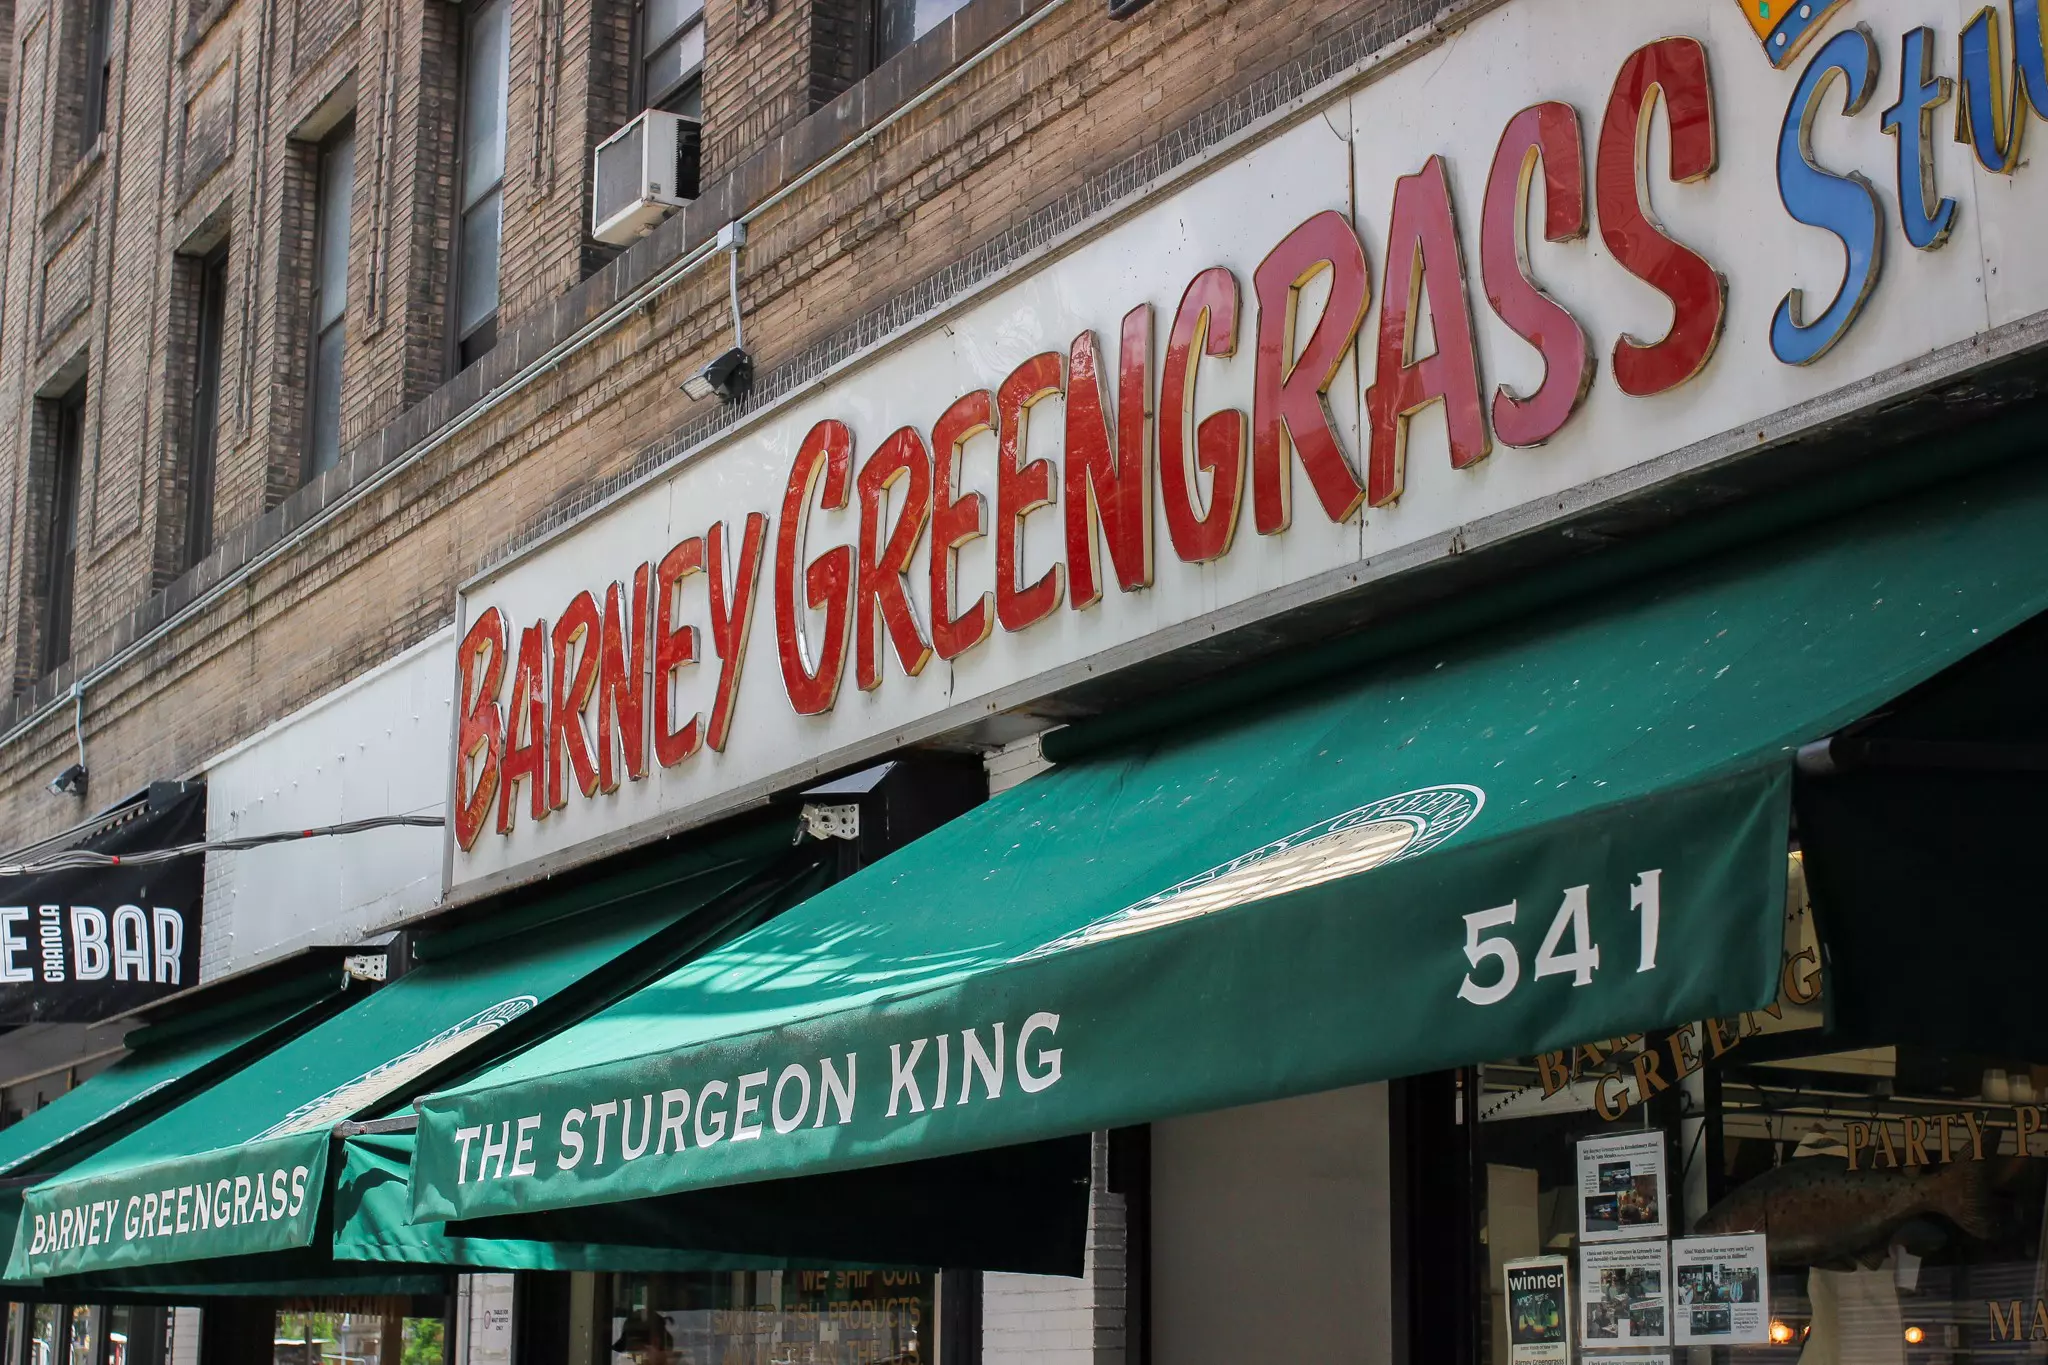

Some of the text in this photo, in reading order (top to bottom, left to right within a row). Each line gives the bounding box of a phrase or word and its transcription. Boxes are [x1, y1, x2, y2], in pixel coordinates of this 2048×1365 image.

[455, 35, 1728, 852] BARNEY GREENGRASS
[0, 904, 184, 985] E GRANOLA BAR
[1456, 868, 1663, 1006] 541
[455, 1012, 1062, 1184] THE STURGEON KING
[1843, 1103, 2048, 1172] PARTY P
[29, 1165, 309, 1256] BARNEY GREENGRASS
[713, 1296, 921, 1335] SMOKED FISH PRODUCTS
[802, 1270, 826, 1291] WE
[1509, 1271, 1563, 1291] winner
[848, 1339, 882, 1365] THE
